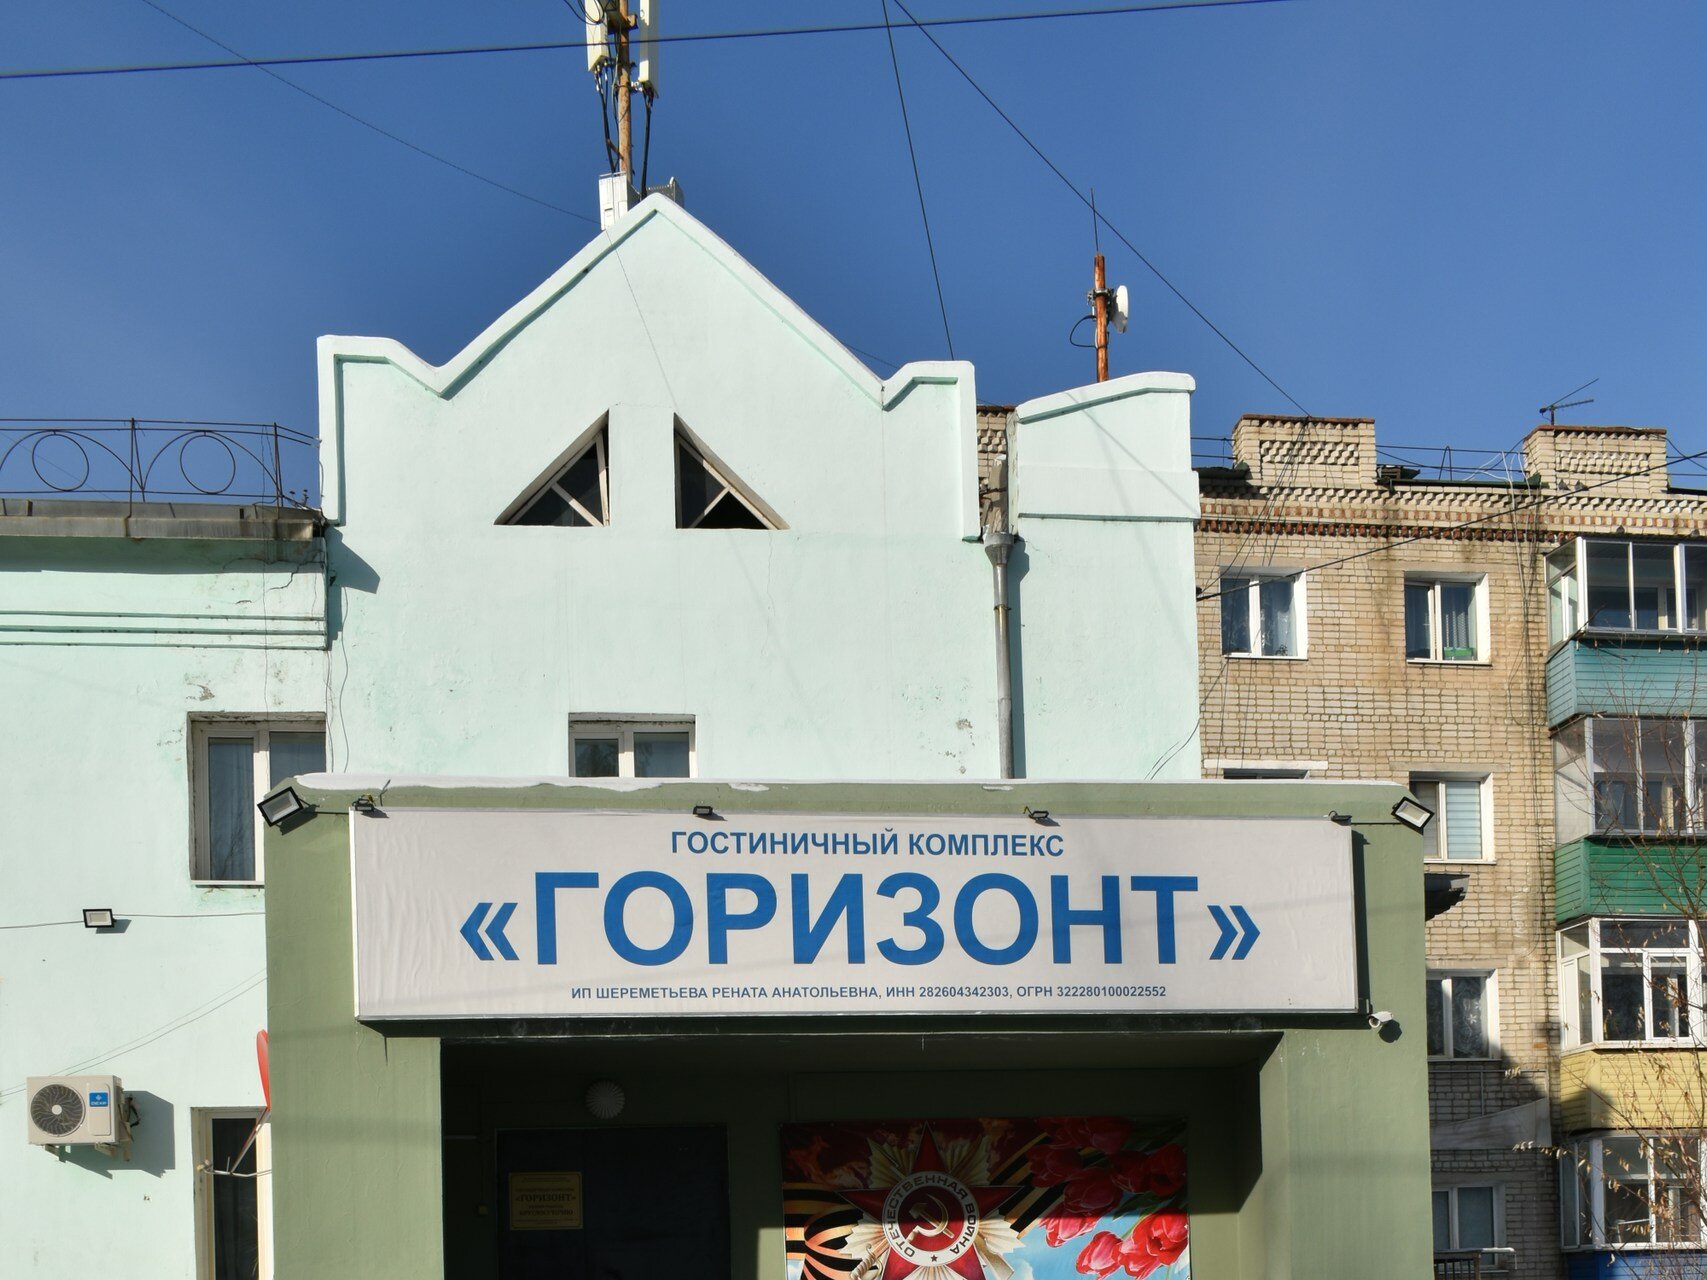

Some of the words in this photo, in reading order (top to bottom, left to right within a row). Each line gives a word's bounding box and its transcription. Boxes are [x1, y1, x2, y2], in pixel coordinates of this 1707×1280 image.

[672, 828, 899, 856] ГОСТИНИЧНЫЙ
[909, 833, 1064, 857] КОМПЛЕКС
[459, 870, 1261, 967] «ГОРИЗОНТ»
[571, 987, 592, 1000] ИП
[596, 987, 708, 1000] ШЕРЕМЕТЬЕВА
[712, 987, 768, 1000] РЕНАТА
[772, 986, 882, 1001] АНАТОЛЬЕВНА,
[886, 986, 915, 999] ИНН
[919, 986, 1013, 1000] 282604342303,
[1016, 986, 1053, 998] ОГРН
[1057, 986, 1167, 998] 322280100022552
[887, 1174, 969, 1258] ОТЕЧЕСТВЕННАЯ
